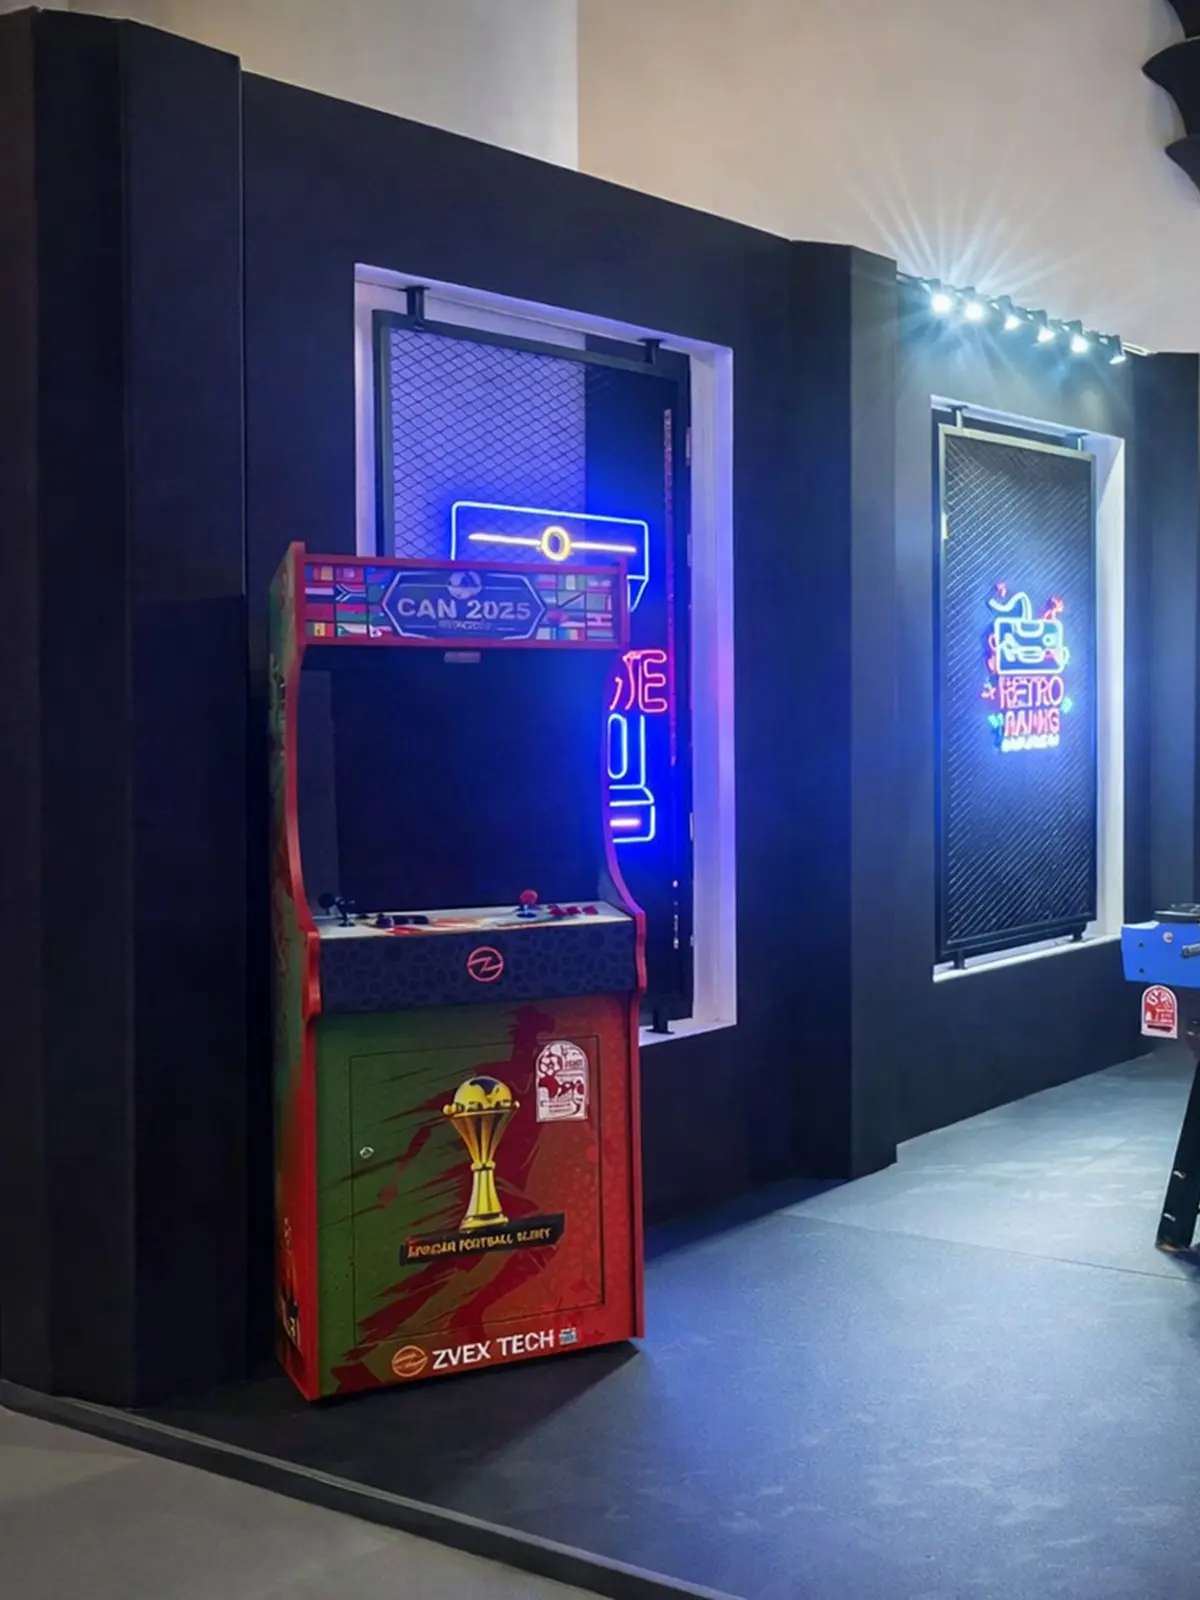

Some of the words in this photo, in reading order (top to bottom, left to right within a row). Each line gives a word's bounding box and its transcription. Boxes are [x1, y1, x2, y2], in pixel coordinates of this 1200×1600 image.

[397, 597, 457, 619] CAN
[465, 599, 531, 621] 2025
[999, 675, 1065, 709] RETRO
[432, 1340, 491, 1370] ZVEX
[497, 1329, 555, 1356] TECH
